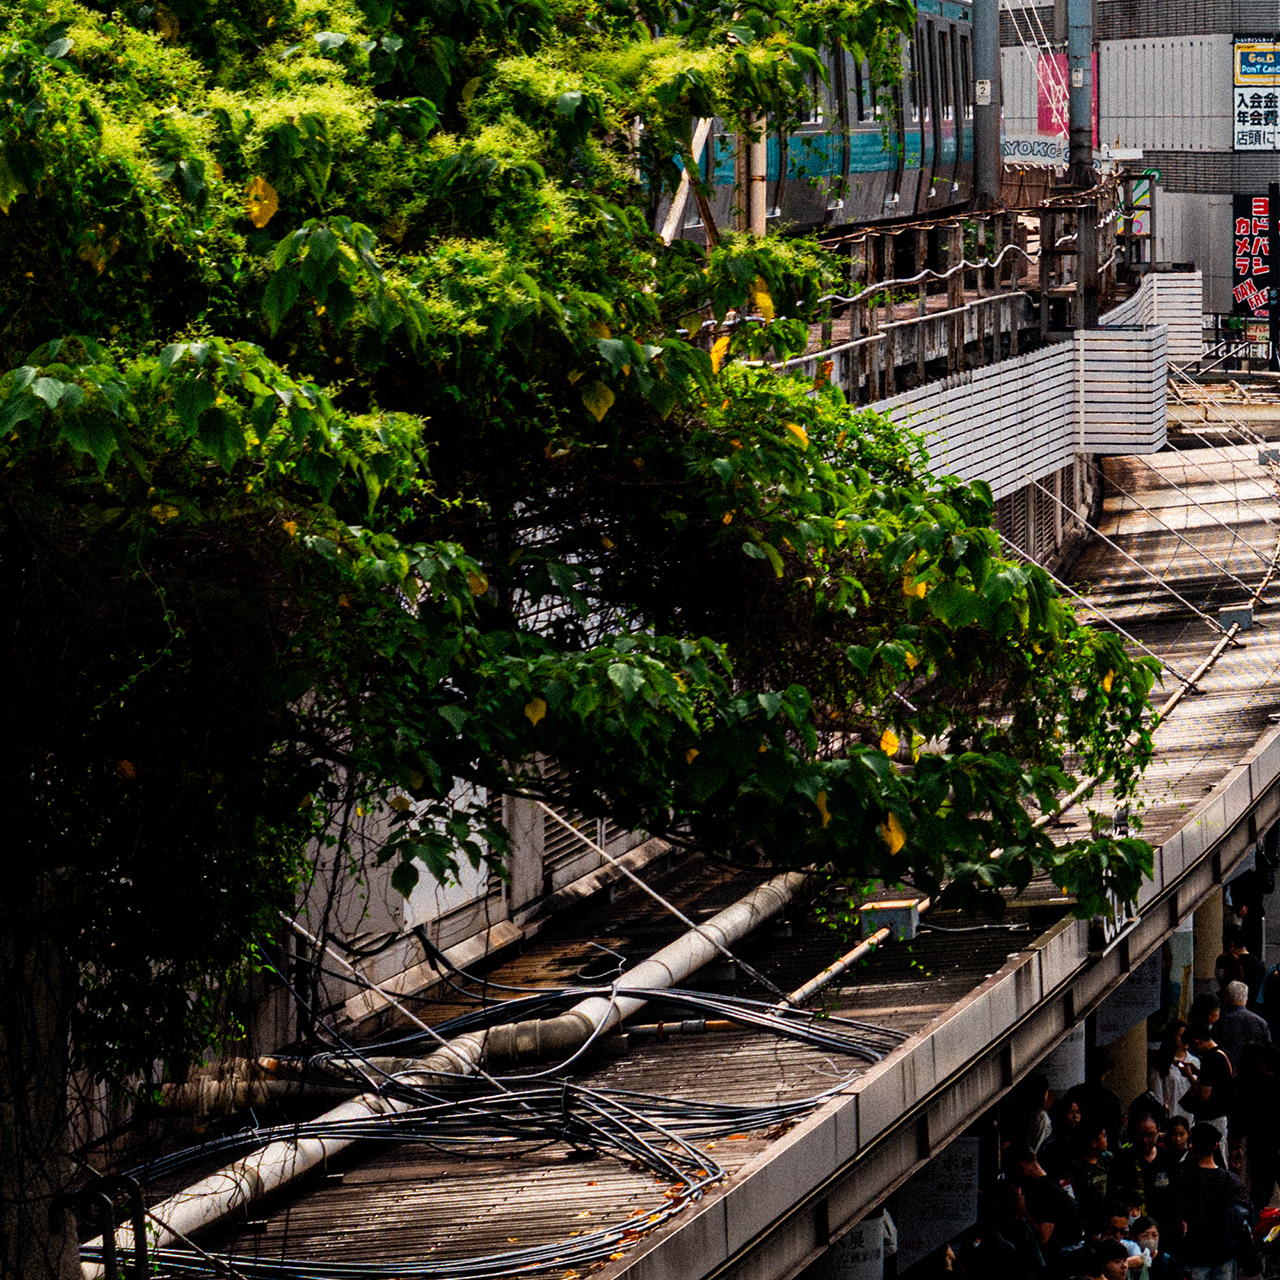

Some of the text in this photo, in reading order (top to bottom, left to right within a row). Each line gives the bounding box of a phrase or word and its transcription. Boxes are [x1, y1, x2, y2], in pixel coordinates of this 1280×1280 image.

[1237, 93, 1279, 109] 入会金
[1237, 110, 1279, 127] 年会費
[1235, 216, 1250, 276] カメラ
[1251, 197, 1269, 276] ヨドバシ
[1232, 277, 1258, 304] TAX
